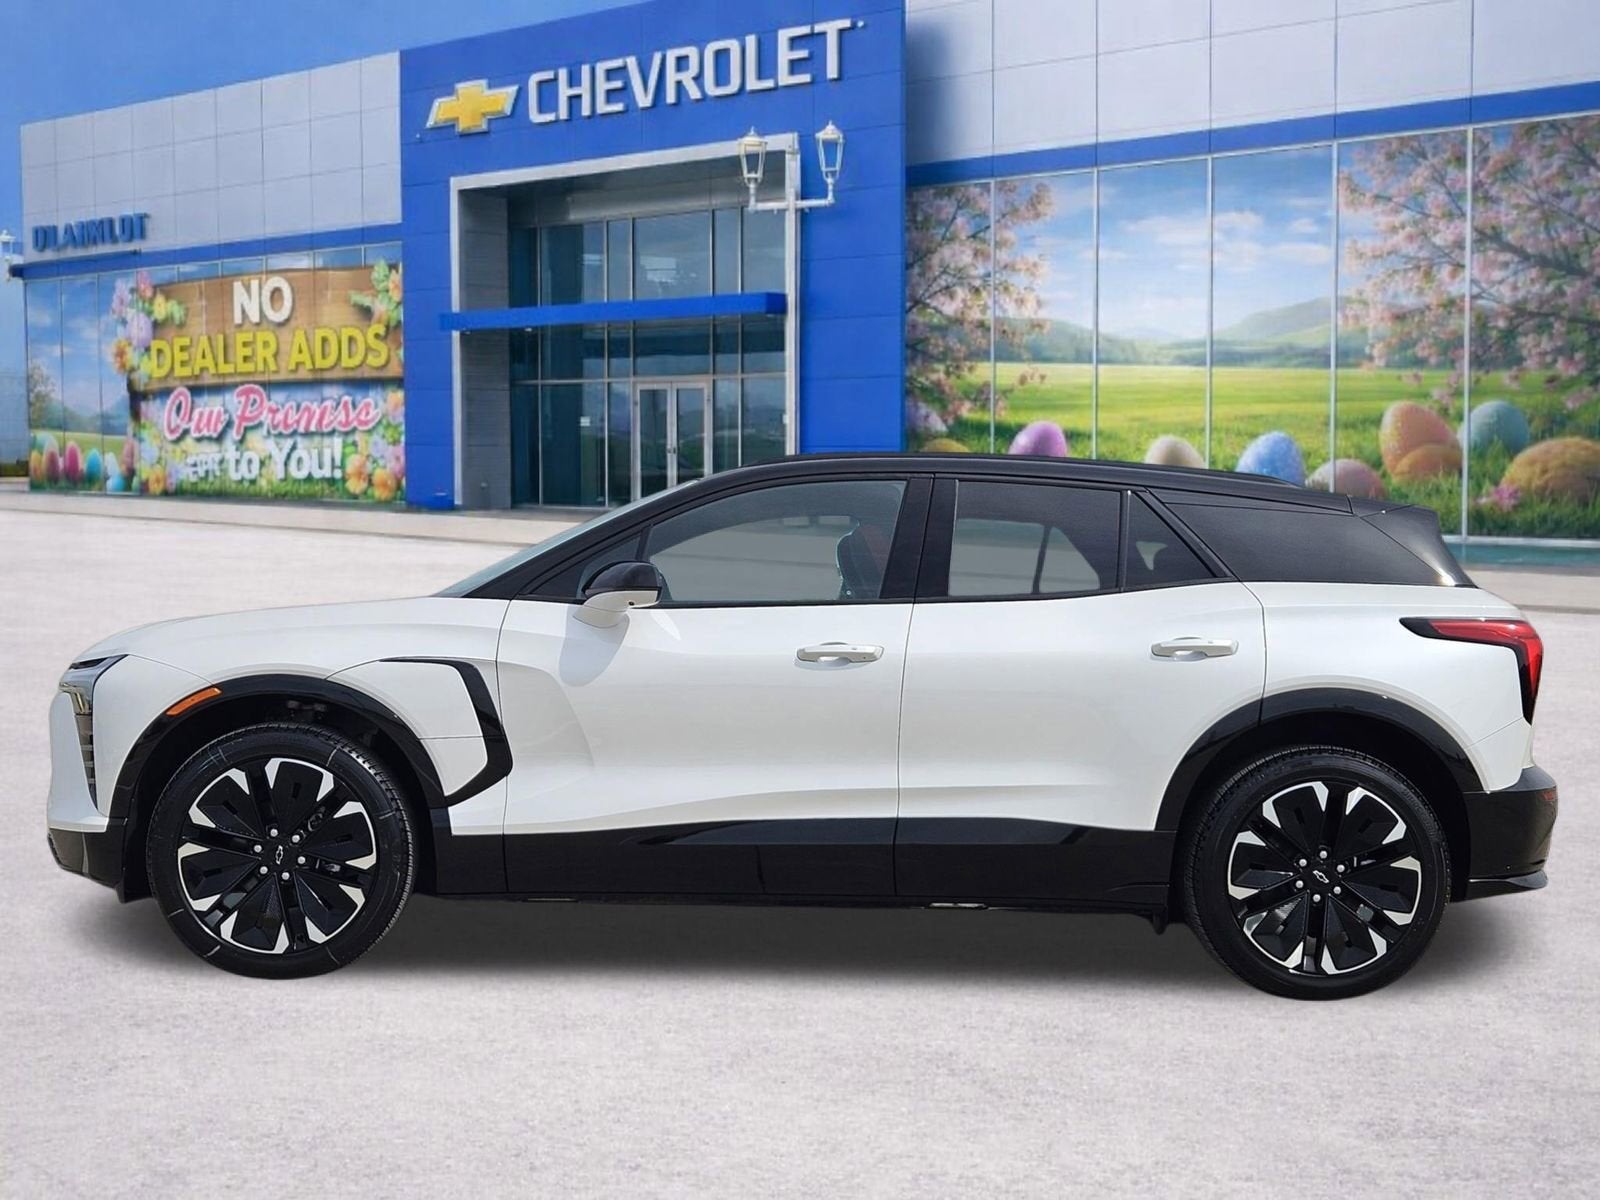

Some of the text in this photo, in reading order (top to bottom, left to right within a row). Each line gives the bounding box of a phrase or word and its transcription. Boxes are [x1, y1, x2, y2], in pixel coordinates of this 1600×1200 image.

[528, 18, 853, 124] CHEVROLET
[233, 276, 293, 325] NO
[150, 323, 390, 378] DEALER ADDS
[227, 444, 260, 481] to
[266, 437, 344, 481] You!
